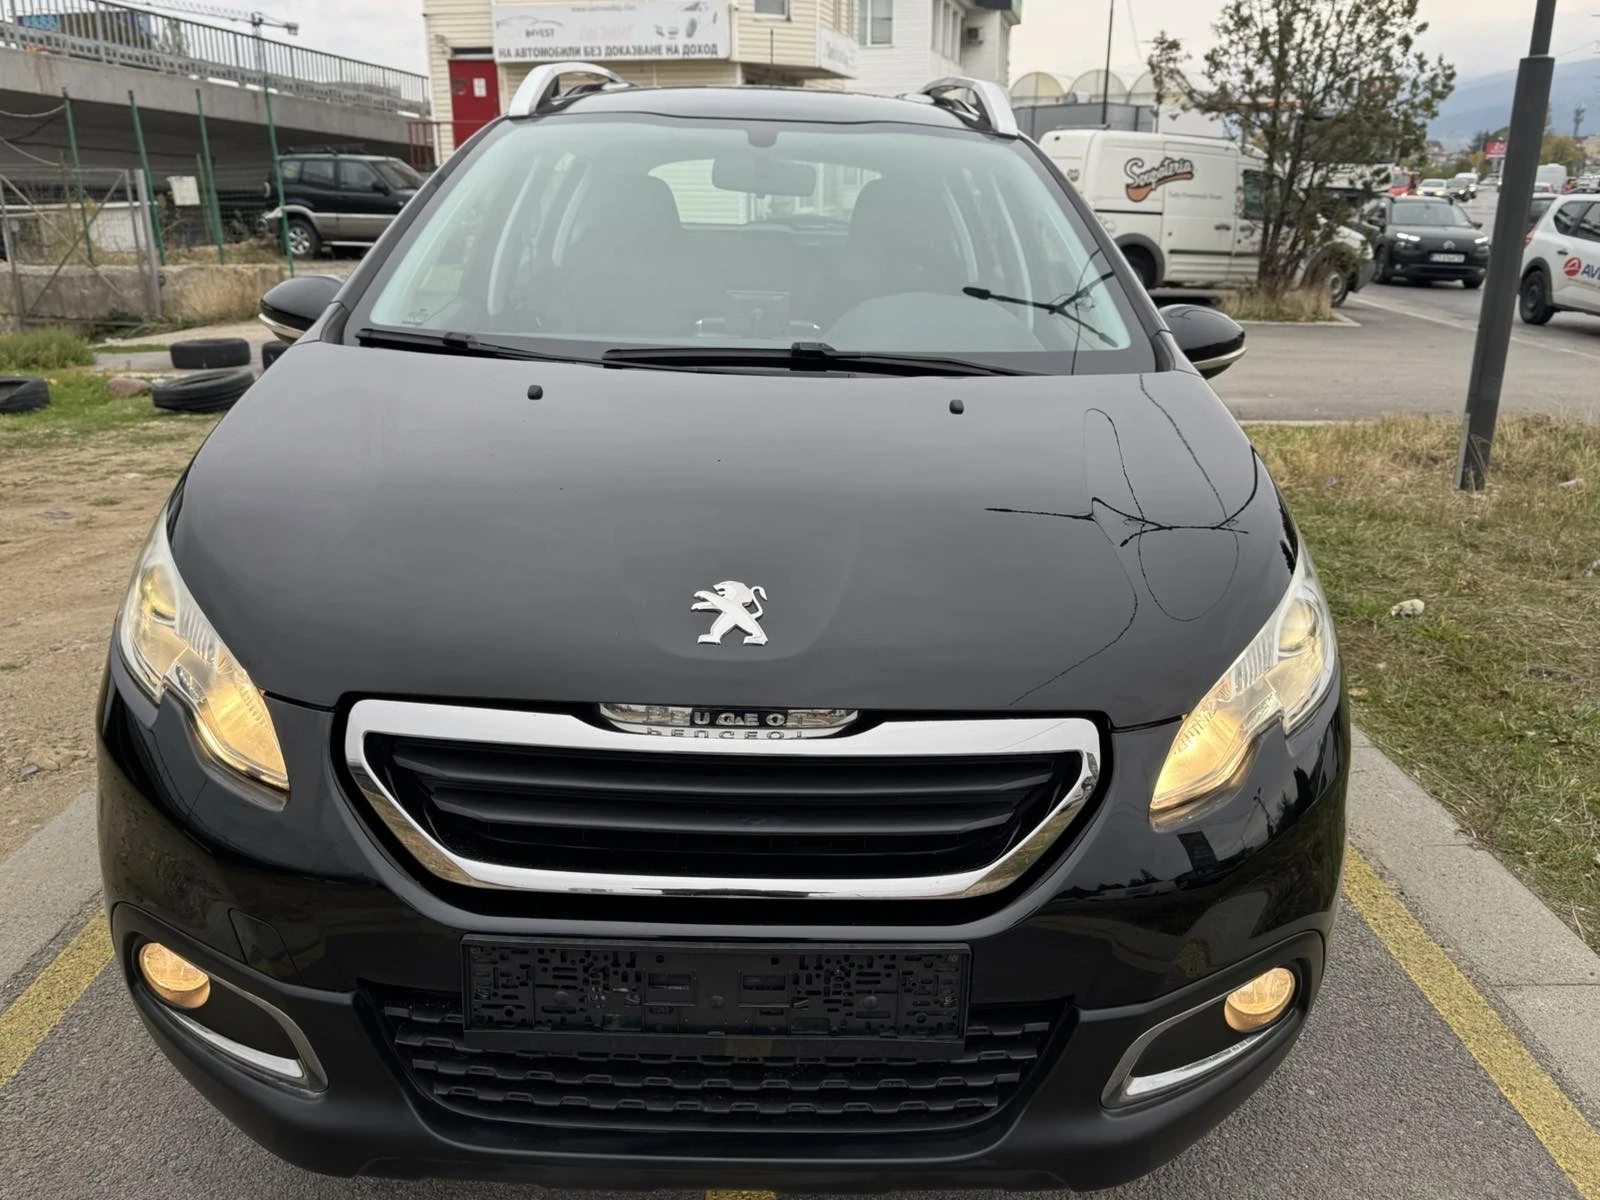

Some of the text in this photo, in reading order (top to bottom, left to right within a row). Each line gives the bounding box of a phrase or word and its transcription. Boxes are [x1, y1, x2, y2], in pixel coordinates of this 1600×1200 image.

[499, 43, 718, 58] НА АВТОМОБИЛИ БЕЗ ДОКАЗВАНЕ НА ДОХОД
[1581, 263, 1600, 281] AV
